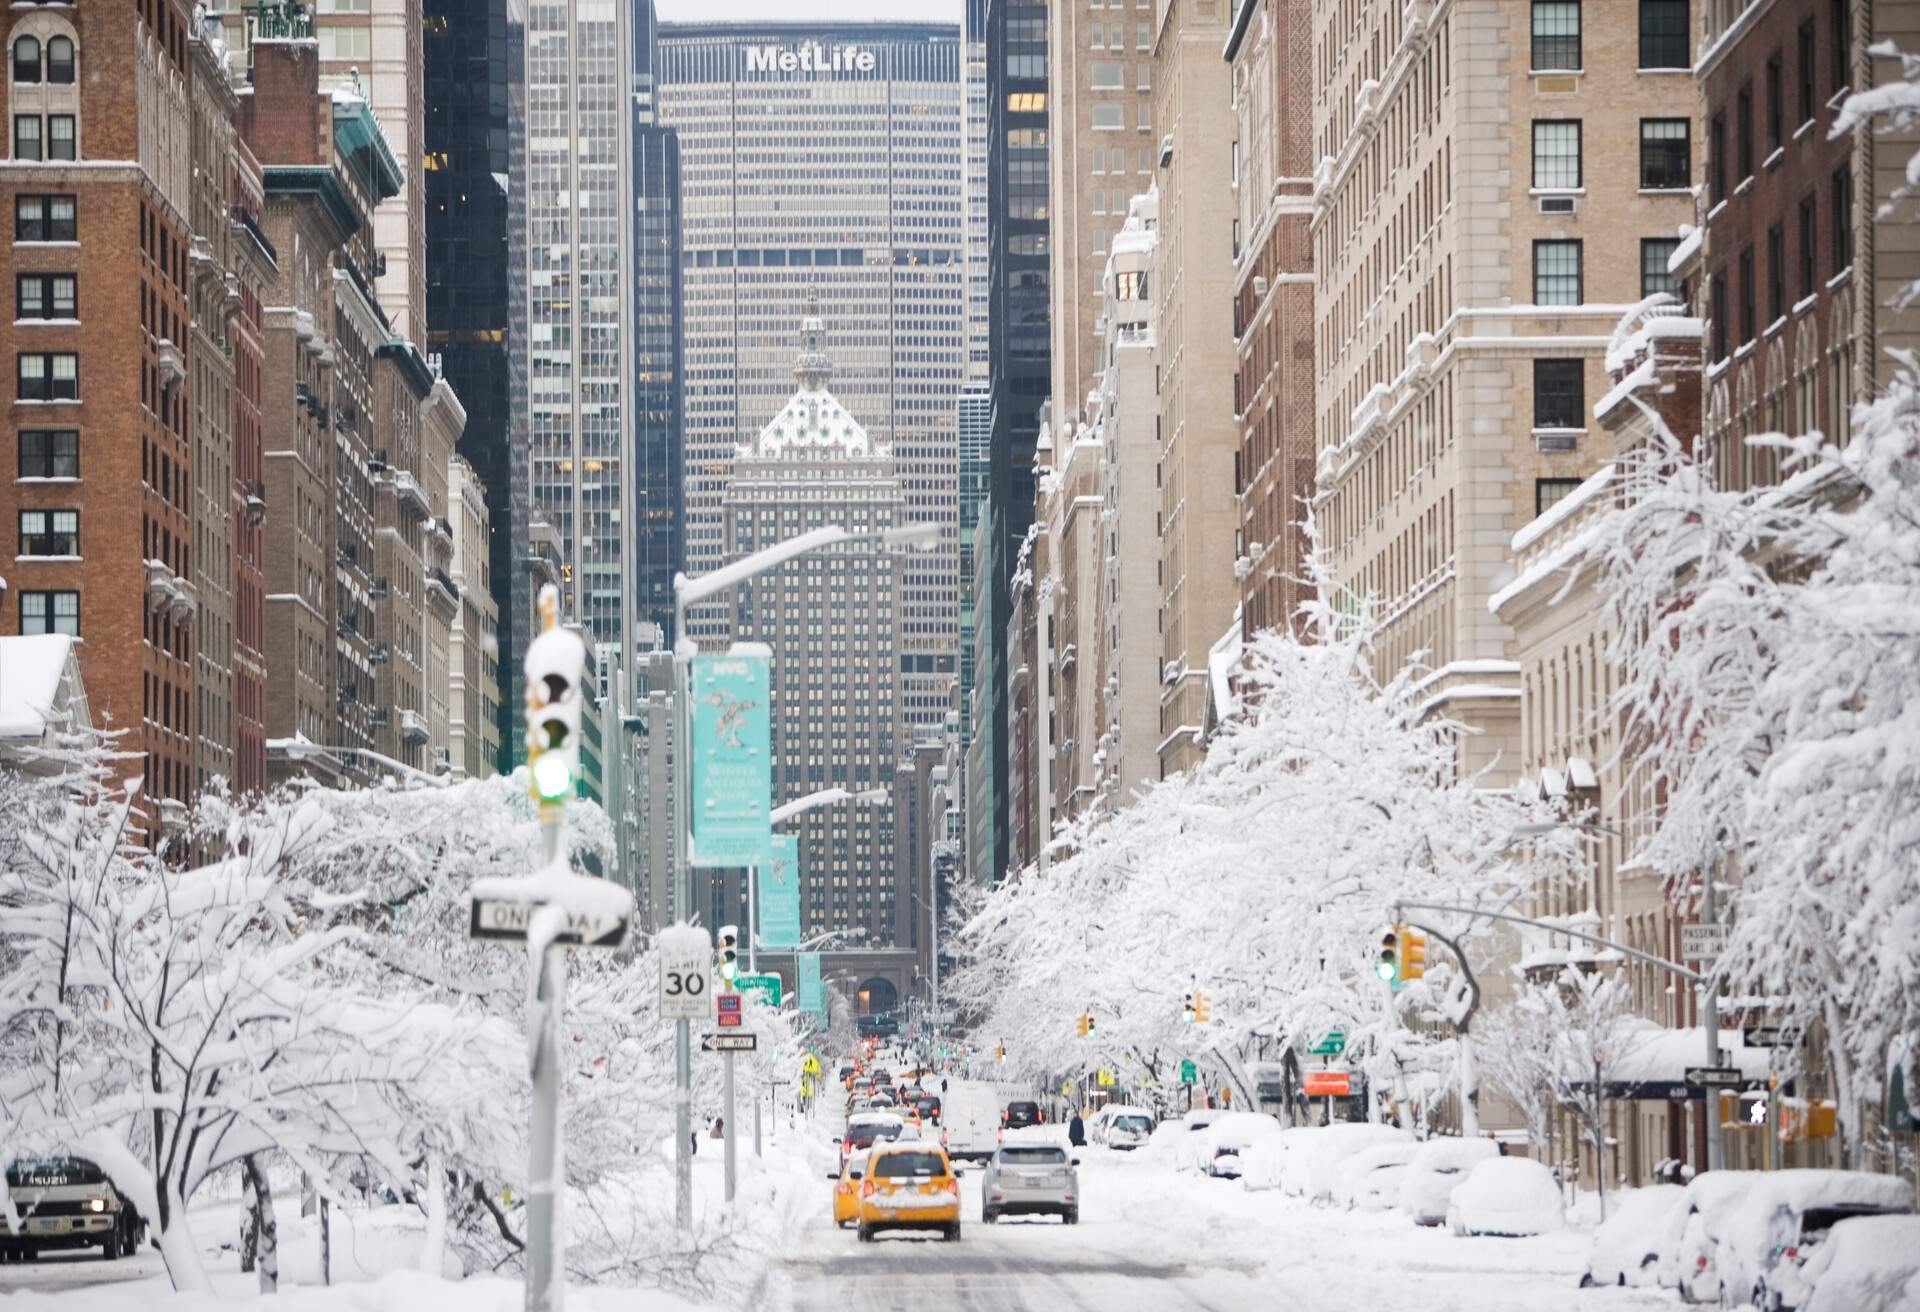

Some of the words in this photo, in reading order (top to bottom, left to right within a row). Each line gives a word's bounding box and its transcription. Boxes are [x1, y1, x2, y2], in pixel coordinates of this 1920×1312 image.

[747, 44, 875, 71] MetLife
[666, 972, 704, 996] 30
[710, 1038, 724, 1046] ONE
[733, 1038, 750, 1046] WAY
[1670, 1087, 1688, 1098] 610
